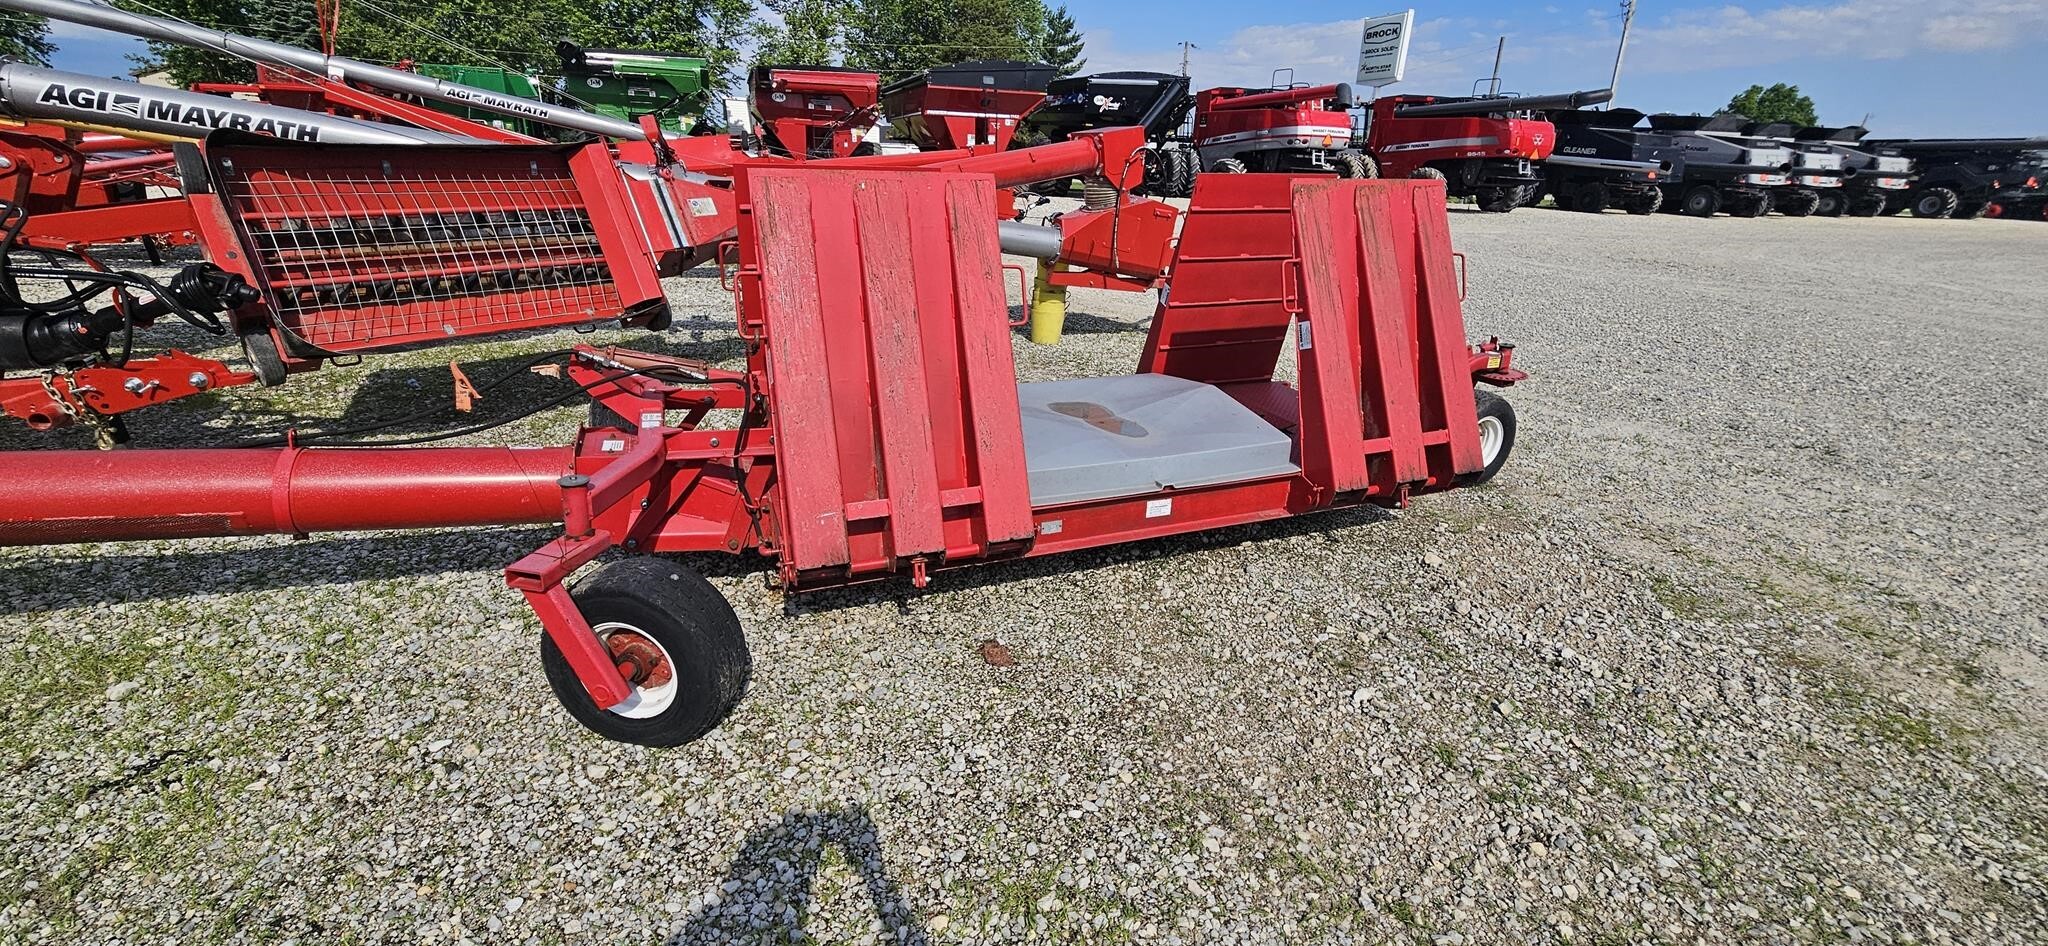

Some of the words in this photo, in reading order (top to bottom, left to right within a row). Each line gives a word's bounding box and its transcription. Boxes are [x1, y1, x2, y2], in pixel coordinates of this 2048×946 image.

[1366, 27, 1399, 40] BROCK
[39, 83, 108, 112] AGI
[147, 100, 320, 142] MAYRATH
[446, 88, 471, 100] AGI
[484, 96, 549, 118] MAYRATH
[1563, 146, 1597, 155] GLEANER
